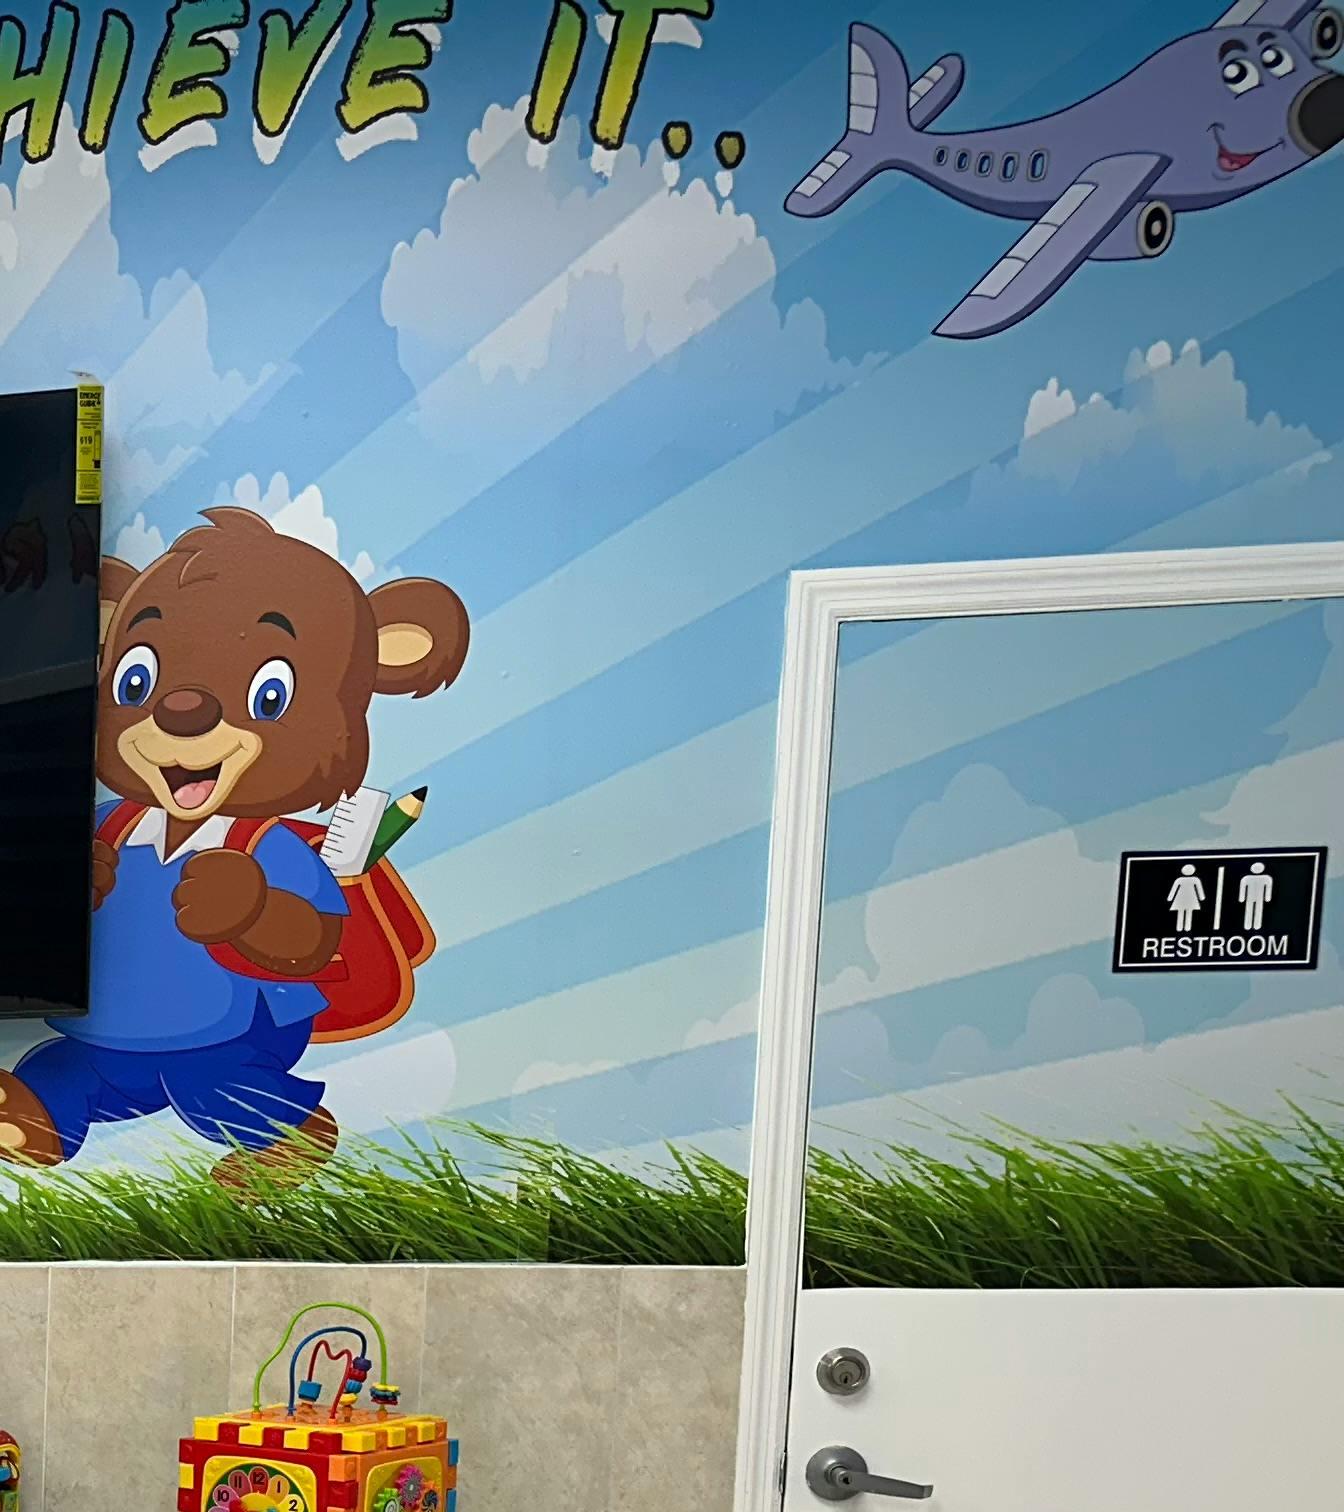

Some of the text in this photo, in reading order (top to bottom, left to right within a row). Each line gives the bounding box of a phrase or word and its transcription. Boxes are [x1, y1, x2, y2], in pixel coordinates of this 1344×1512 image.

[1142, 935, 1289, 958] RESTROOM
[234, 1475, 242, 1489] 11
[253, 1471, 265, 1485] 12
[276, 1480, 281, 1493] 1
[217, 1489, 230, 1502] 10
[288, 1499, 298, 1512] 2
